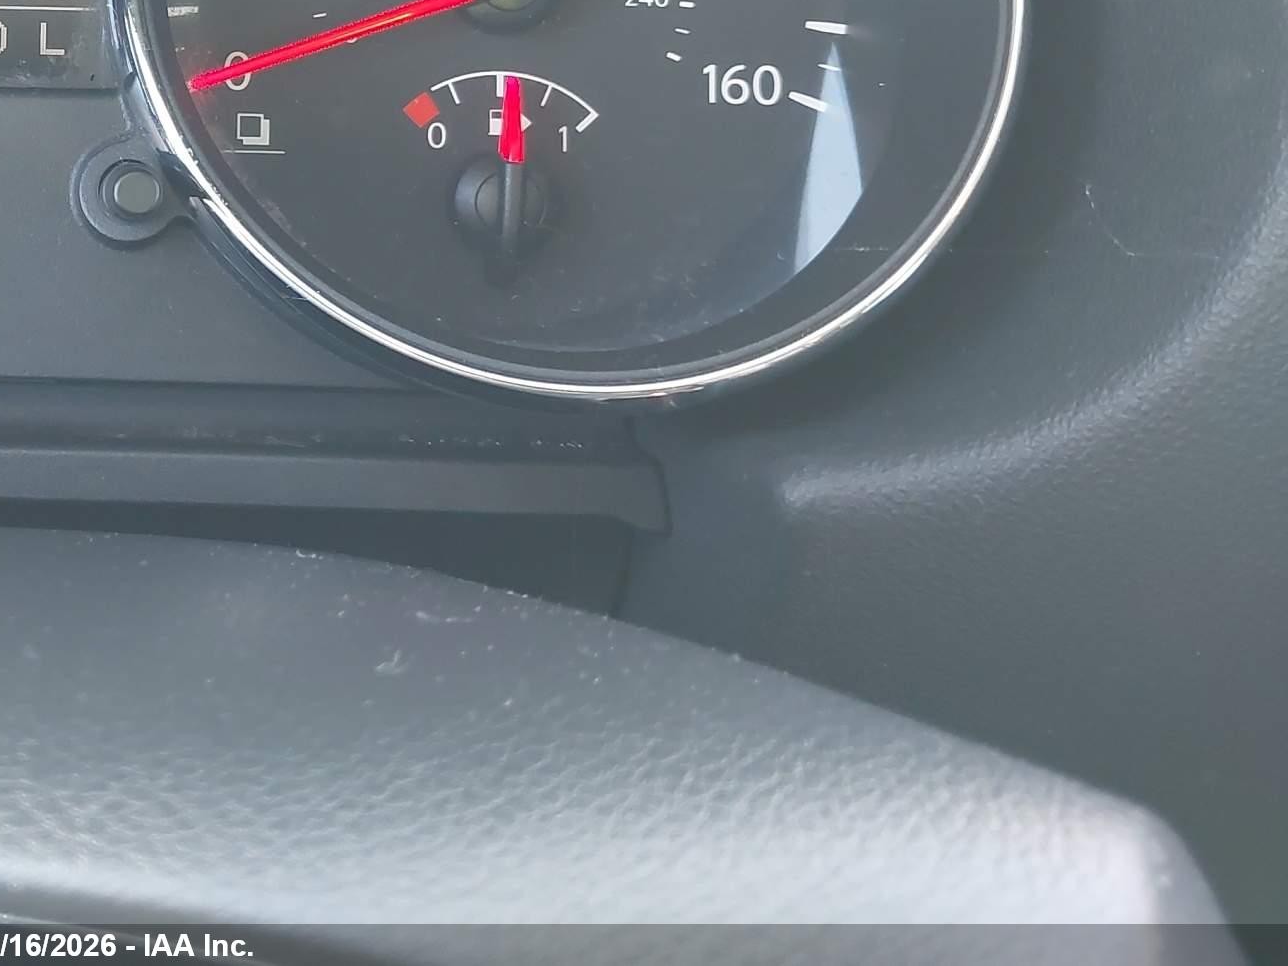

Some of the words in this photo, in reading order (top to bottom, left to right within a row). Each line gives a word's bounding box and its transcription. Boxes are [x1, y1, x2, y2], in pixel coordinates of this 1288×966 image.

[39, 22, 65, 56] L
[224, 52, 253, 91] 0
[702, 64, 782, 104] 160
[427, 123, 446, 148] 0
[558, 125, 568, 151] 1
